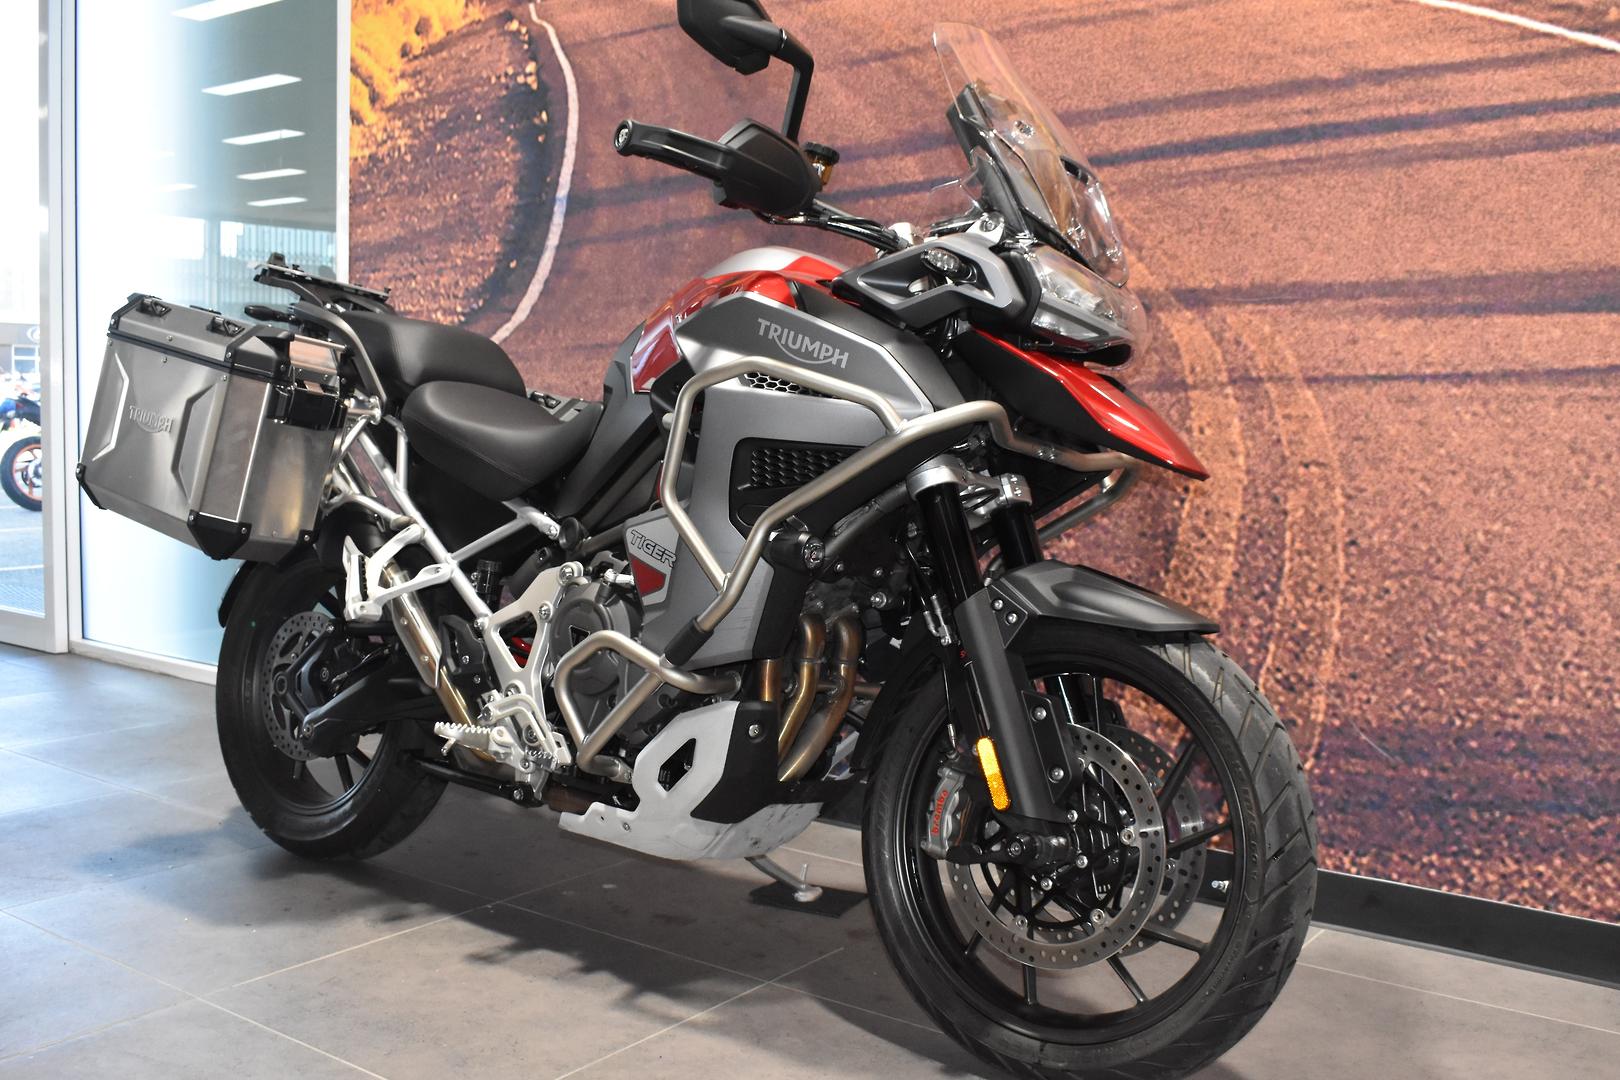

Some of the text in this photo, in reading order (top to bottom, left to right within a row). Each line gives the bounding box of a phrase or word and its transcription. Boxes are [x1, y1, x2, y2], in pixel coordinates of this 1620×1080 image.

[757, 317, 850, 369] TRIUMPH
[129, 405, 175, 433] TRIUMPH
[630, 529, 676, 568] TIGER
[930, 788, 950, 837] brembo
